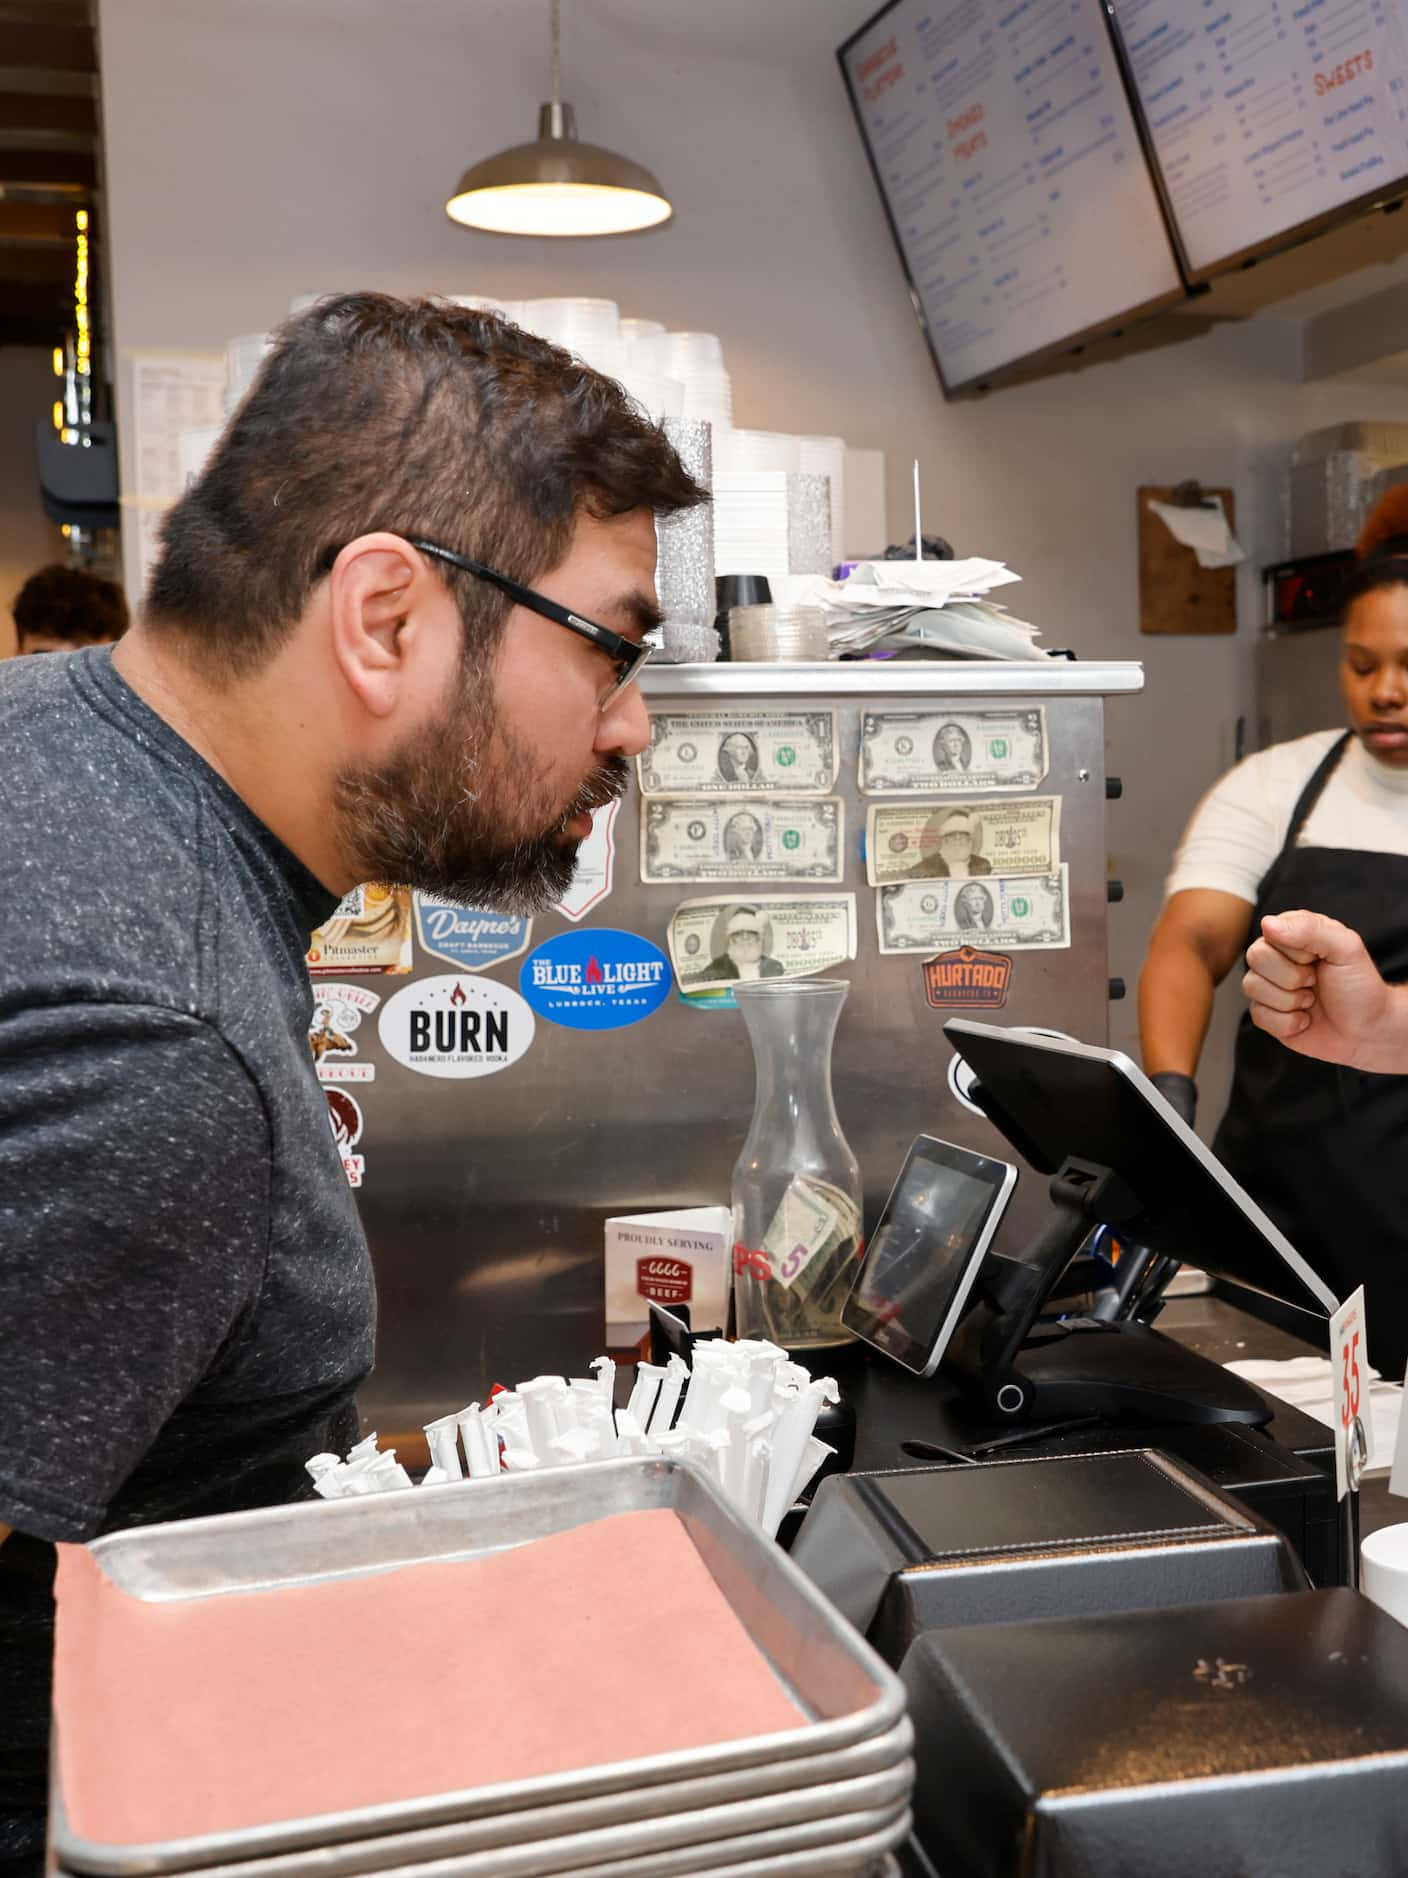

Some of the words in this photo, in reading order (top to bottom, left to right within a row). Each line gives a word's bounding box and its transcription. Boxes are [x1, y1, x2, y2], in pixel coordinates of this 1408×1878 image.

[1314, 48, 1374, 96] SWEETS
[426, 908, 521, 942] Dayne's
[532, 964, 582, 985] BLUE
[602, 961, 664, 983] LIGHT
[928, 962, 1007, 988] HURTADO
[581, 983, 616, 996] LIVE
[409, 1010, 508, 1053] BURN
[617, 1231, 664, 1246] PROUDLY
[666, 1238, 713, 1252] SERVING
[648, 1260, 681, 1277] 6666
[780, 1243, 809, 1279] 5
[648, 1286, 679, 1298] BEEF
